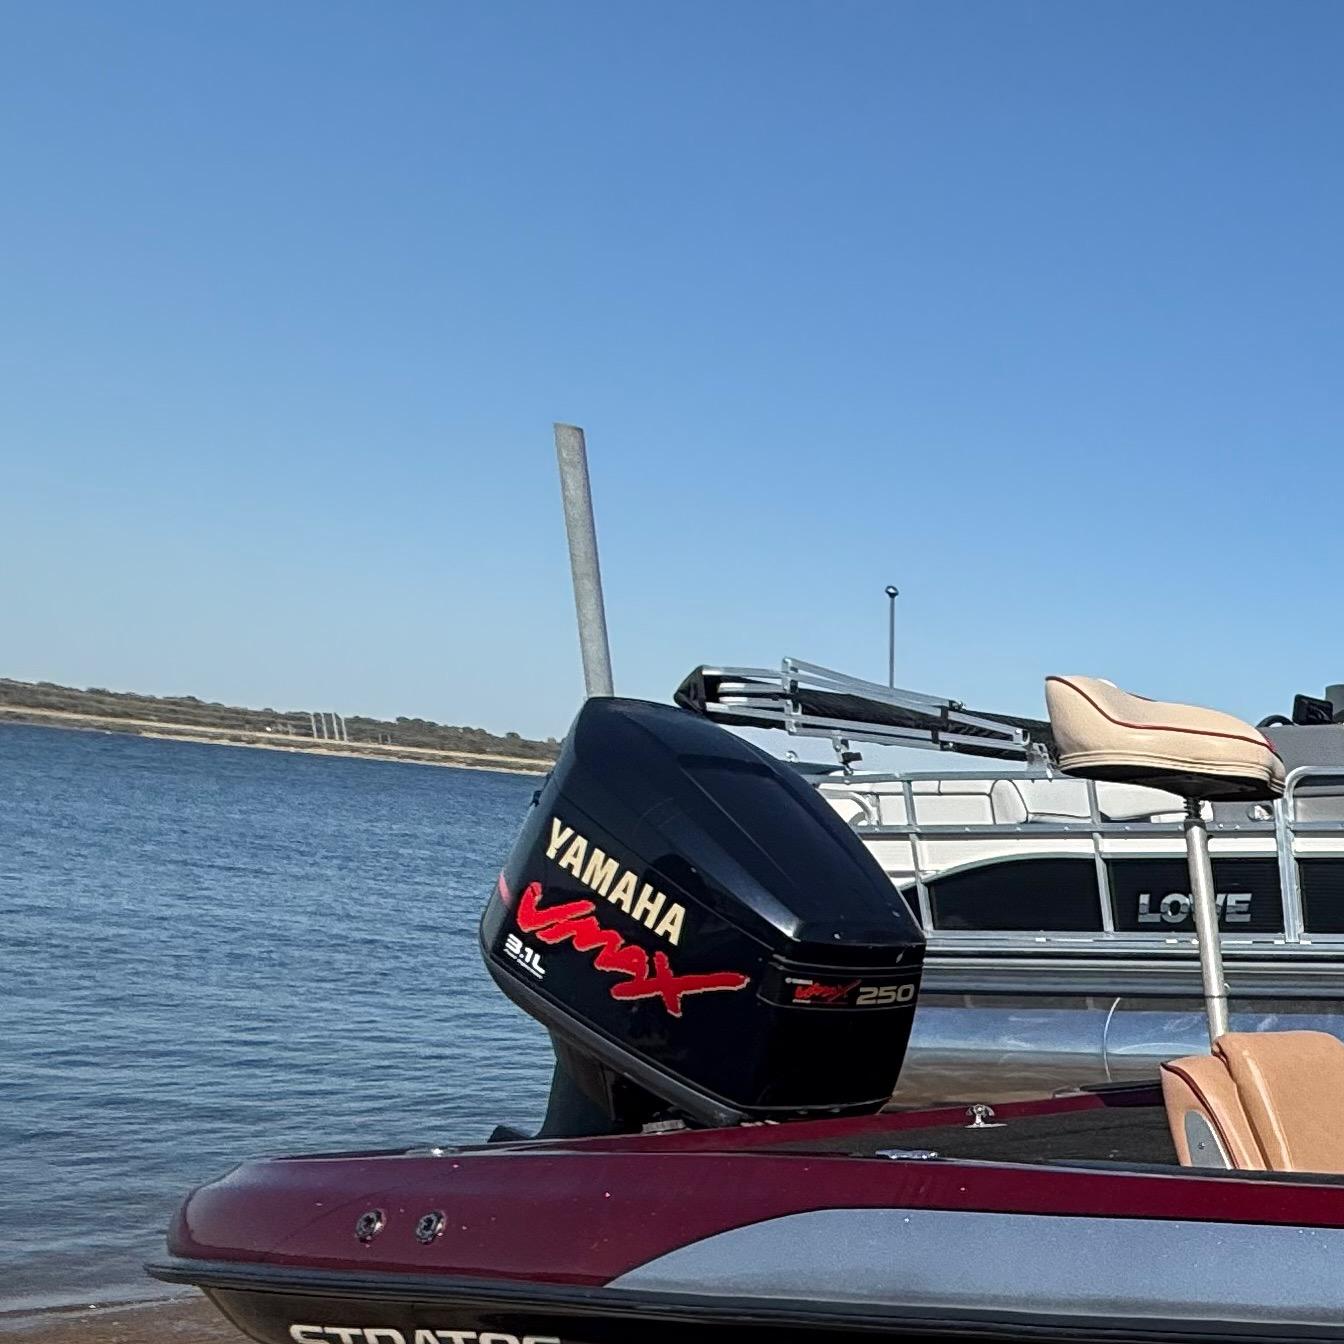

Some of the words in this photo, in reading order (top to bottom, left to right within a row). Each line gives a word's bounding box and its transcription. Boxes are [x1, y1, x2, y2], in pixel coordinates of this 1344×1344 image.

[546, 817, 686, 946] YAMAHA
[505, 933, 546, 975] 3.1L
[856, 984, 915, 1005] 250
